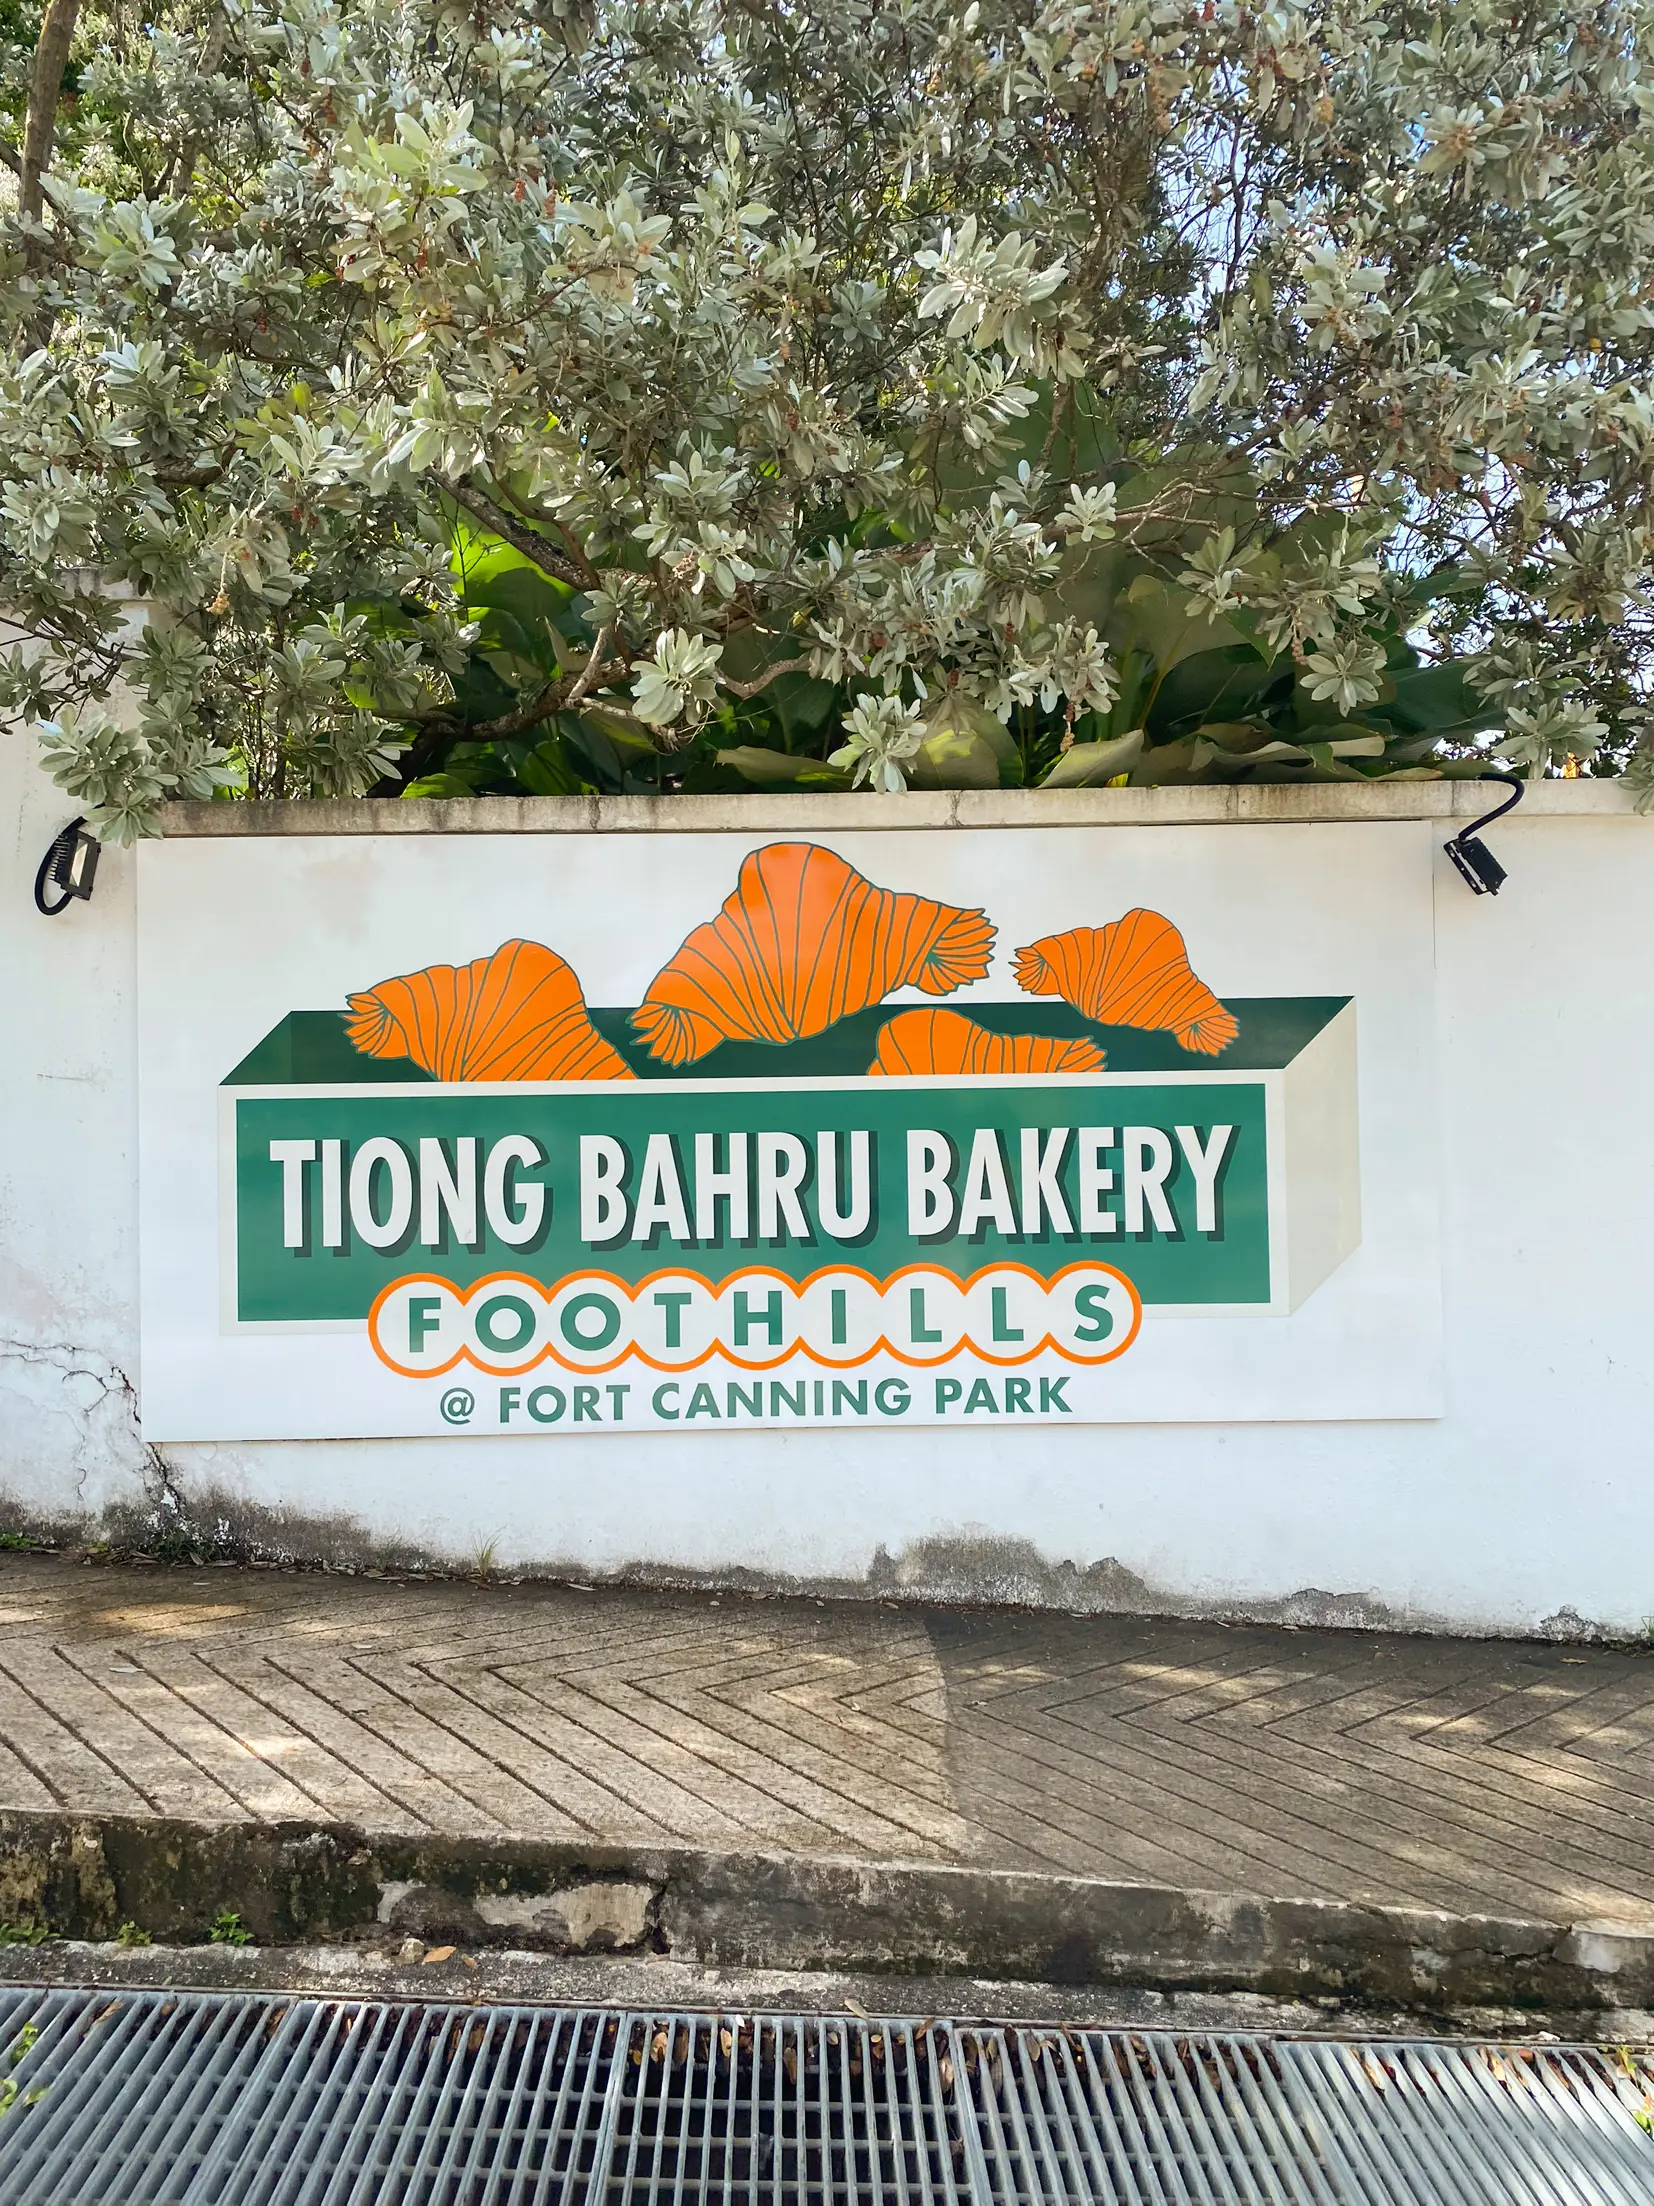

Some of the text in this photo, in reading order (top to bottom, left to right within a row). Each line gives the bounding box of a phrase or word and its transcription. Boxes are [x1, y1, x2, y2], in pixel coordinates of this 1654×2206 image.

[269, 1124, 1237, 1251] TIONG BAHRU BAKERY
[408, 1284, 1114, 1354] FOOTHILLS
[440, 1376, 1073, 1425] @ FORT CANNING PARK
